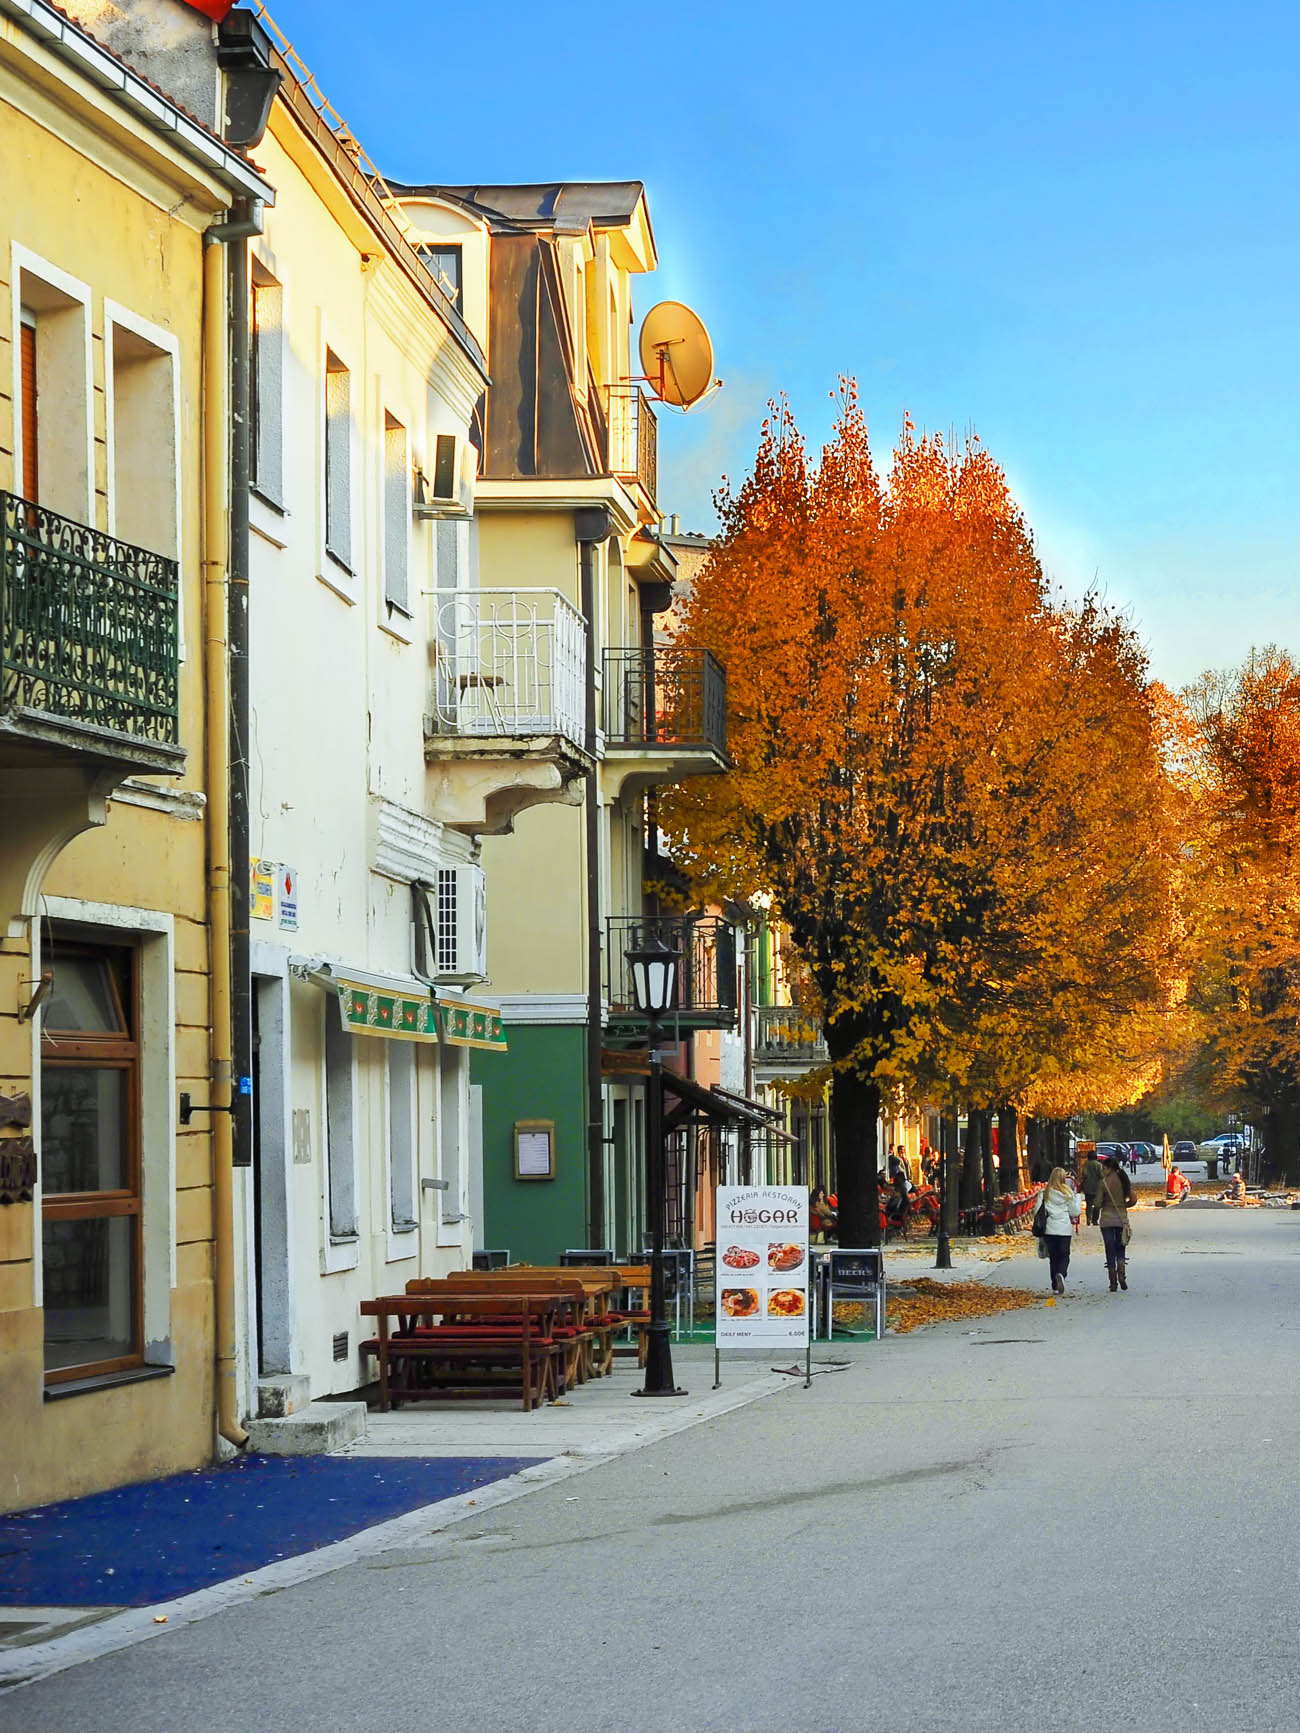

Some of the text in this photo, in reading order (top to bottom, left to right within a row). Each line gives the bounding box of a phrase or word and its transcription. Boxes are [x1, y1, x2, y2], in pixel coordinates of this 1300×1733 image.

[726, 1190, 802, 1209] PIZZERIA RESTORAN
[731, 1209, 798, 1223] HOGAR
